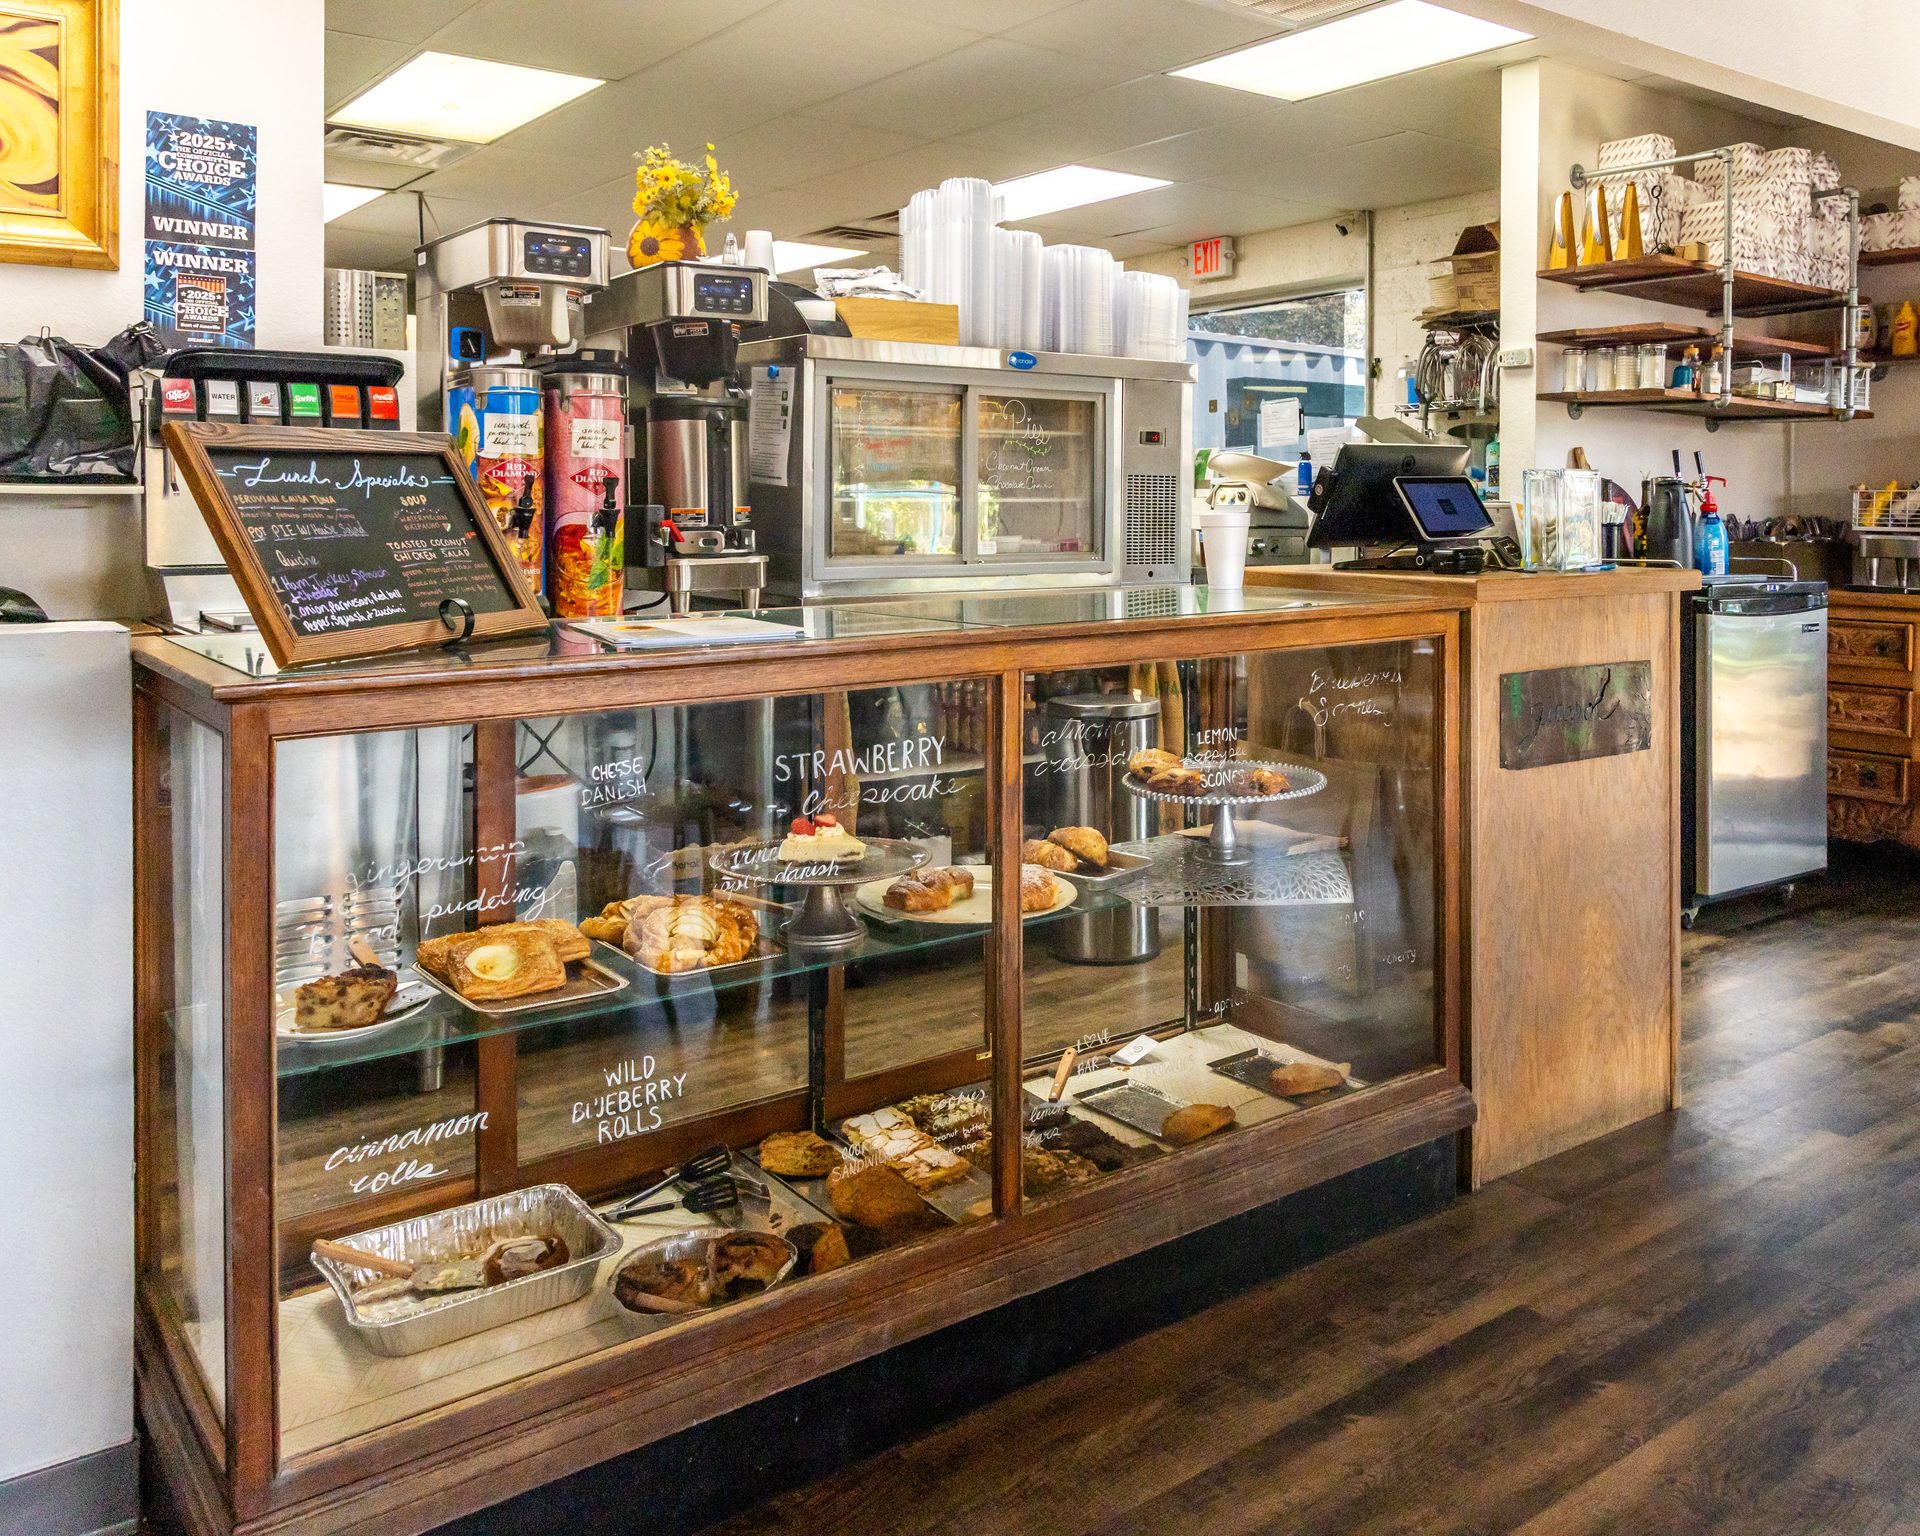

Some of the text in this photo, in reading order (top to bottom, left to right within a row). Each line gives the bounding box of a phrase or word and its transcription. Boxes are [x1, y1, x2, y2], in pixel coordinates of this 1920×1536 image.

[179, 132, 226, 151] 2025
[176, 145, 231, 159] THE OFFICIAL
[158, 151, 246, 179] CHOICE
[174, 171, 231, 187] AWARDS
[152, 215, 248, 240] WINNER
[153, 250, 249, 274] WINNER
[1194, 240, 1221, 274] EXIT
[187, 290, 216, 301] 2025
[174, 302, 229, 319] CHOICE
[183, 314, 219, 323] AWARDS
[294, 394, 317, 403] Sprite
[372, 393, 394, 401] Coca-Cola
[492, 469, 539, 479] DIAMOND
[506, 463, 527, 472] RED
[589, 467, 609, 477] RED
[232, 457, 430, 499] Lunch Specials
[575, 474, 605, 483] DIAM
[310, 494, 337, 506] TUNA
[399, 494, 427, 507] SOUP
[399, 514, 448, 523] WATERMELON
[247, 525, 268, 539] POT
[271, 524, 297, 538] PIE
[338, 520, 366, 536] Salad
[386, 537, 468, 550] TOASTED COCONUT
[275, 549, 320, 568] Quiche
[393, 548, 471, 562] CHICKEN SALAD
[388, 588, 403, 599] bell
[1197, 727, 1238, 746] LEMON
[774, 735, 945, 782] STRAWBERRY
[1199, 769, 1245, 789] SCONES
[419, 882, 563, 935] pudding
[603, 1055, 656, 1088] WILD
[1077, 1056, 1100, 1077] BAR
[1029, 1104, 1067, 1123] lemon
[597, 1105, 662, 1144] ROLLS
[324, 1110, 489, 1172] cinnamon
[933, 1129, 959, 1146] peanut
[349, 1159, 449, 1194] rolls
